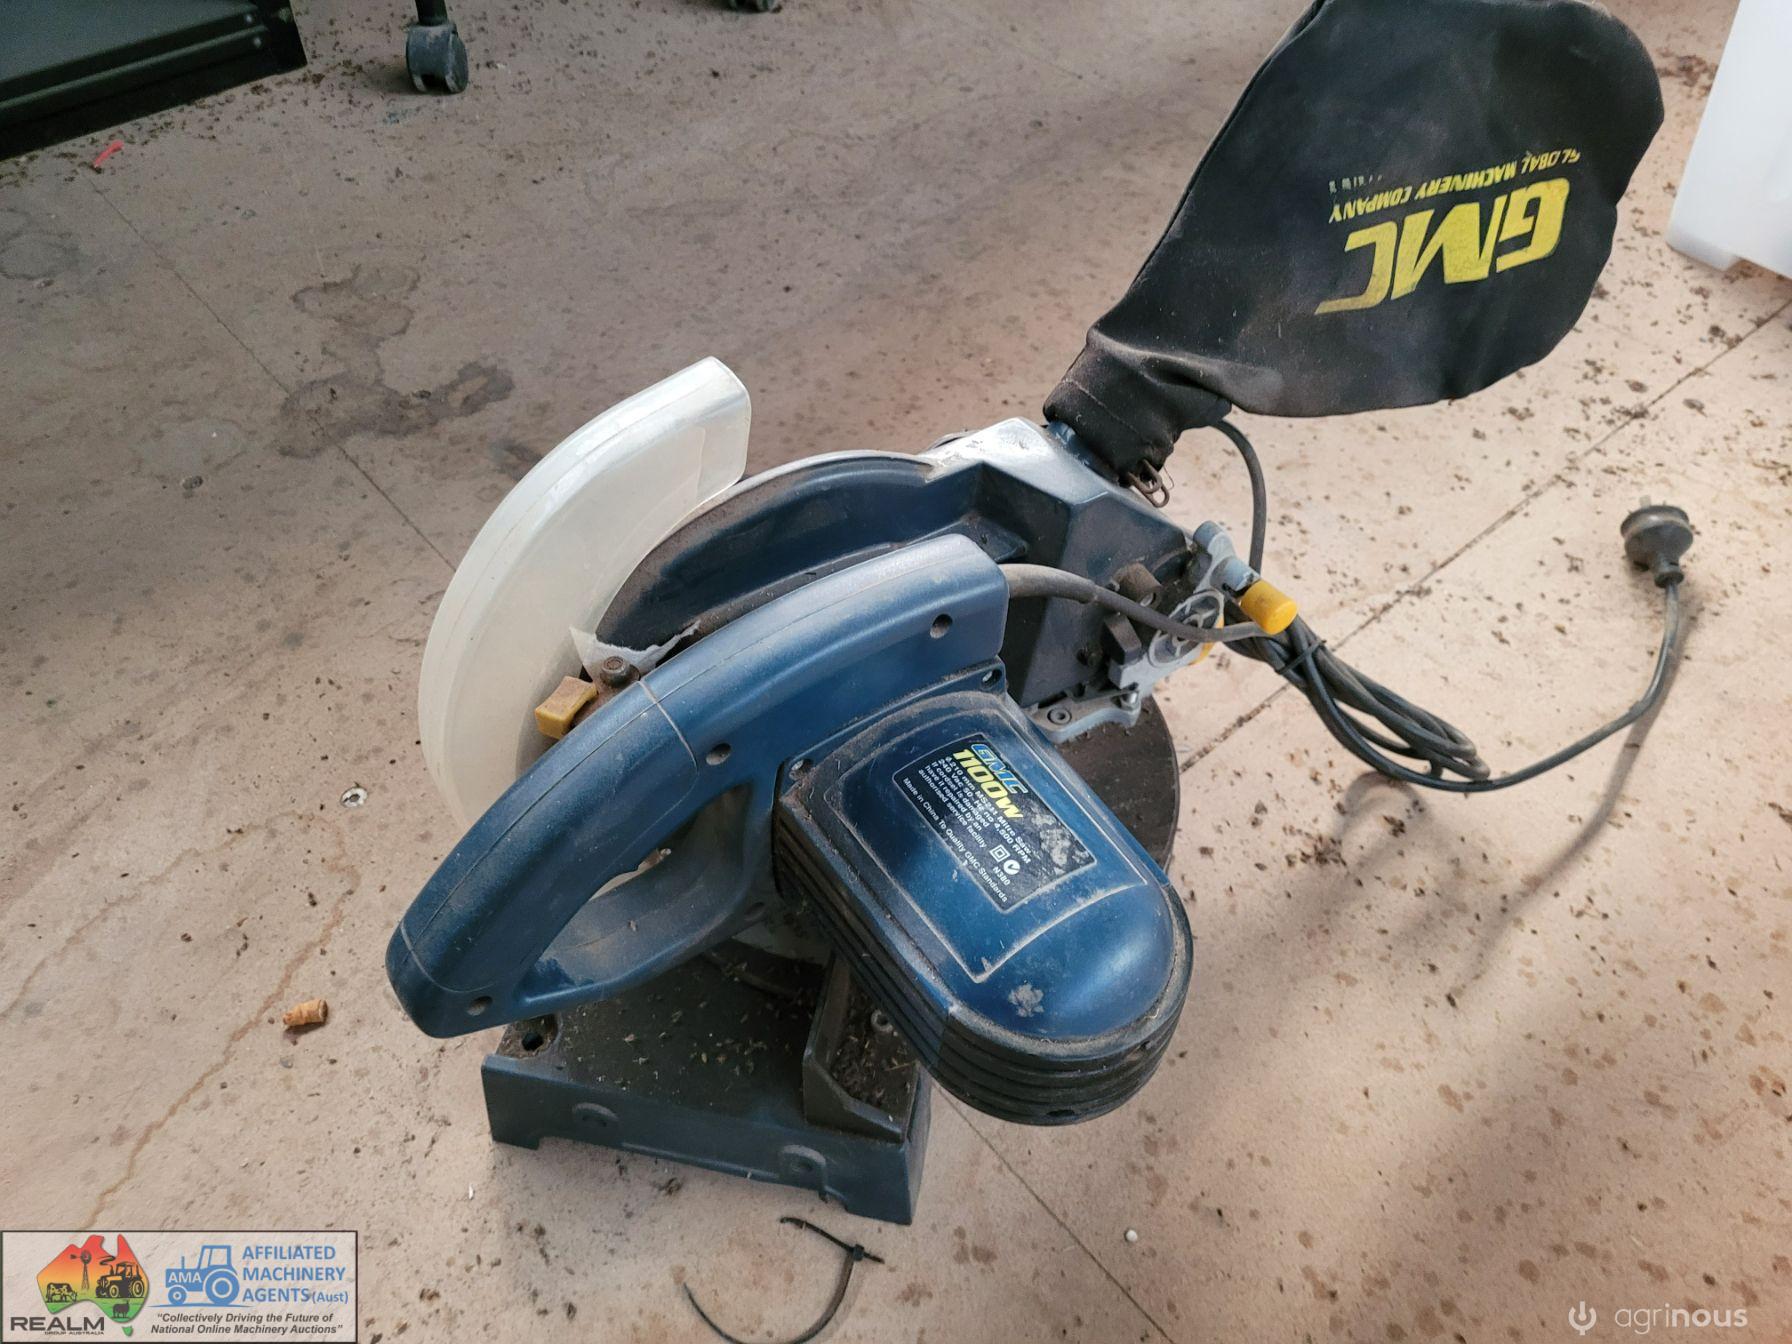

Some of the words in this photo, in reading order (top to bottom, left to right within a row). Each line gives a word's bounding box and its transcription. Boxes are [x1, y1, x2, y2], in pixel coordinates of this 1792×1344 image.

[1328, 185, 1412, 225] COMPANY
[1415, 160, 1517, 201] MACHINERY
[1314, 177, 1570, 316] GMC
[925, 765, 939, 781] have
[943, 787, 968, 813] repaired
[965, 812, 974, 821] by
[973, 822, 982, 831] an
[937, 768, 958, 791] cordset
[963, 798, 990, 828] damaged
[971, 743, 1029, 794] GMC
[904, 778, 918, 795] Made
[923, 802, 939, 821] China
[939, 820, 946, 829] To
[946, 829, 966, 852] Quality
[965, 851, 980, 869] GMC
[979, 868, 1007, 902] Standards
[919, 770, 949, 803] authorised
[947, 803, 968, 826] service
[967, 825, 987, 848] facility
[938, 759, 951, 773] 240
[952, 773, 964, 787] Vac
[1013, 844, 1031, 863] RPM
[962, 776, 975, 790] mm
[997, 816, 1015, 836] Mitre
[1015, 837, 1031, 854] Saw
[993, 867, 1010, 885] N380
